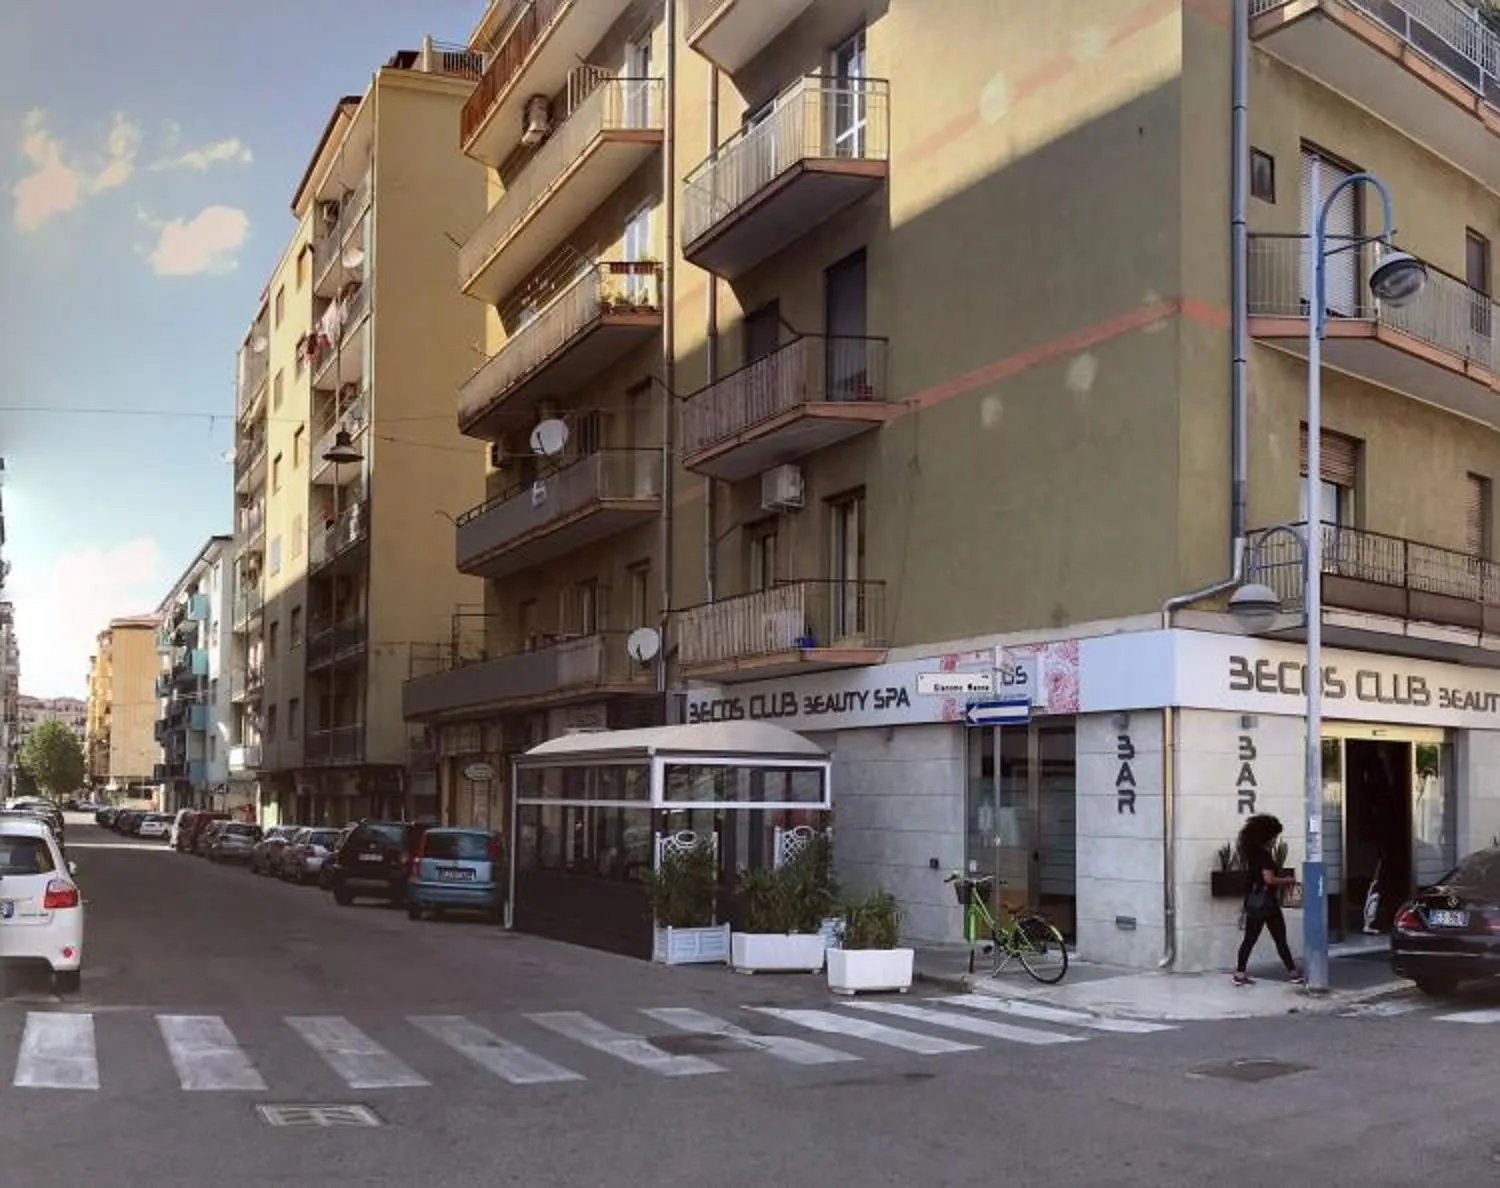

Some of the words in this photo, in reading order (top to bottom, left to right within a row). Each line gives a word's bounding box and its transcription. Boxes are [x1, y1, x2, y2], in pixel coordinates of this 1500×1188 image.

[689, 698, 745, 724] BECOS
[749, 691, 799, 718] CLUB
[803, 689, 869, 714] BEAUTY
[873, 687, 911, 709] SPA
[1356, 670, 1431, 706] CLUB
[1115, 734, 1136, 814] BAR
[1236, 735, 1257, 814] BAR
